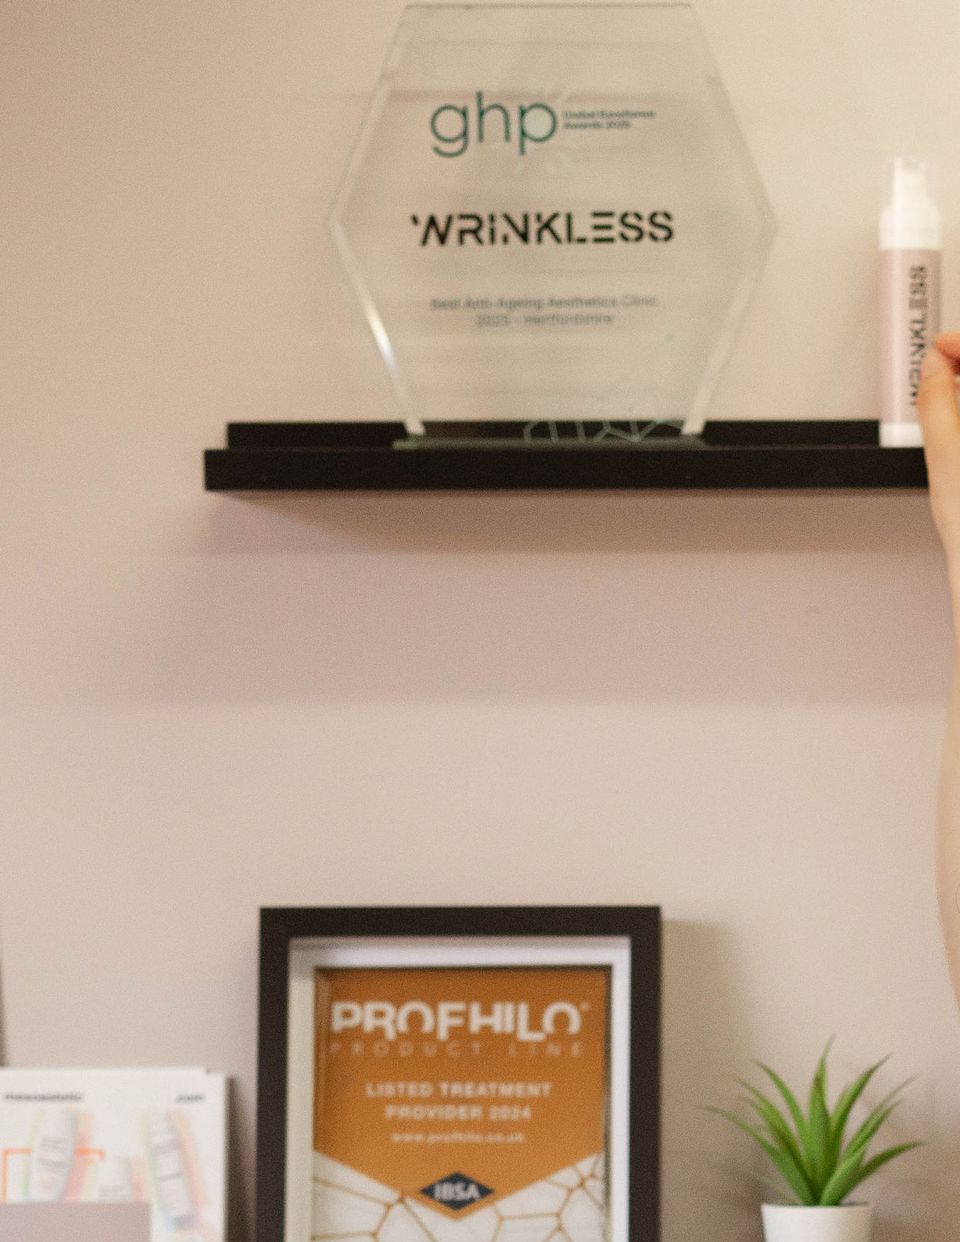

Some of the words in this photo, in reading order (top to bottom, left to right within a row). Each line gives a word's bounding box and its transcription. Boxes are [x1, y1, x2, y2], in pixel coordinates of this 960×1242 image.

[429, 90, 558, 159] ghp
[410, 210, 675, 247] WRINKLESS
[329, 1040, 482, 1058] PRODUCT
[508, 1040, 583, 1058] LINE
[365, 1081, 433, 1098] LISTED
[439, 1081, 552, 1098] TREATMENT
[385, 1104, 484, 1121] PROVIDER
[489, 1104, 532, 1121] 2024
[433, 1181, 482, 1202] IBSA
